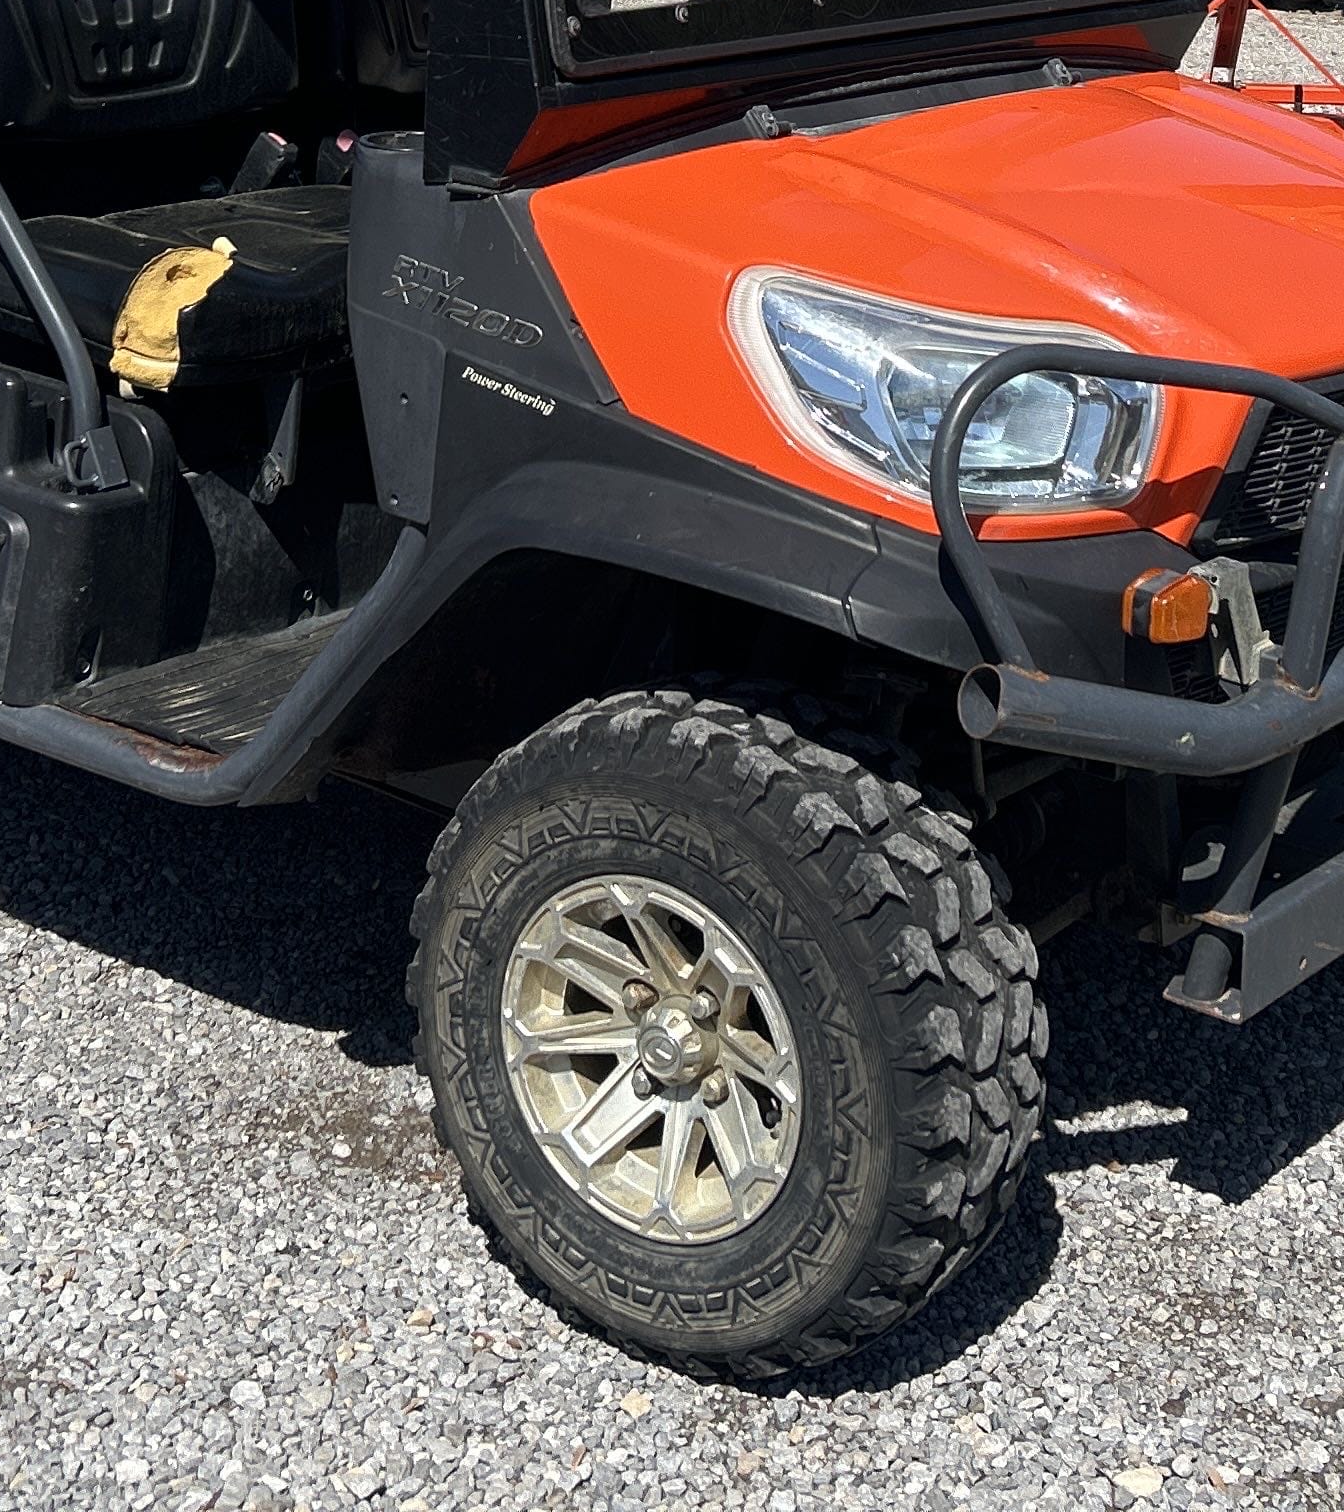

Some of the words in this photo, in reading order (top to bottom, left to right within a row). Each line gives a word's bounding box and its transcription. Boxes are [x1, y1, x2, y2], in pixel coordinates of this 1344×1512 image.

[393, 254, 464, 292] RTV
[461, 366, 503, 392] Power
[500, 382, 557, 417] Steering
